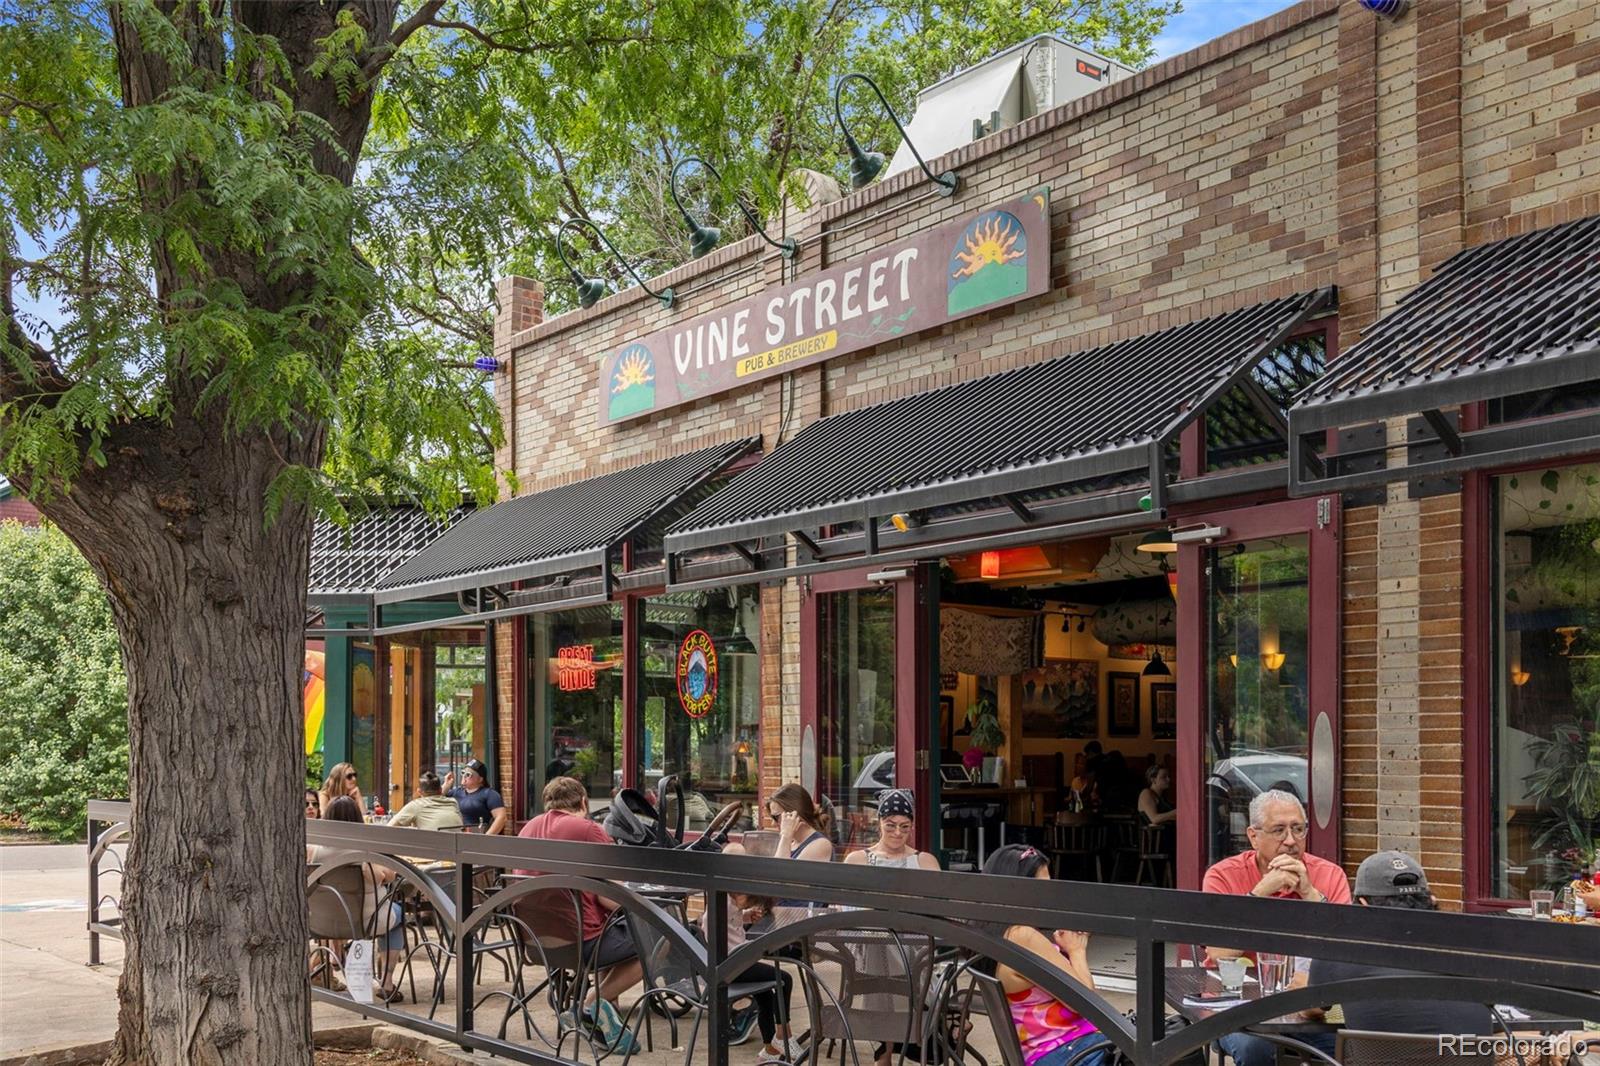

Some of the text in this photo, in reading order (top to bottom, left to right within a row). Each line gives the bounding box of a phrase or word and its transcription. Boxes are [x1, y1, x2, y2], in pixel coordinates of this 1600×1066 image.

[674, 247, 919, 376] VINE STREET
[744, 335, 829, 373] PUB & BREWERY
[680, 634, 698, 676] BLACK
[559, 667, 596, 691] DIVIDE
